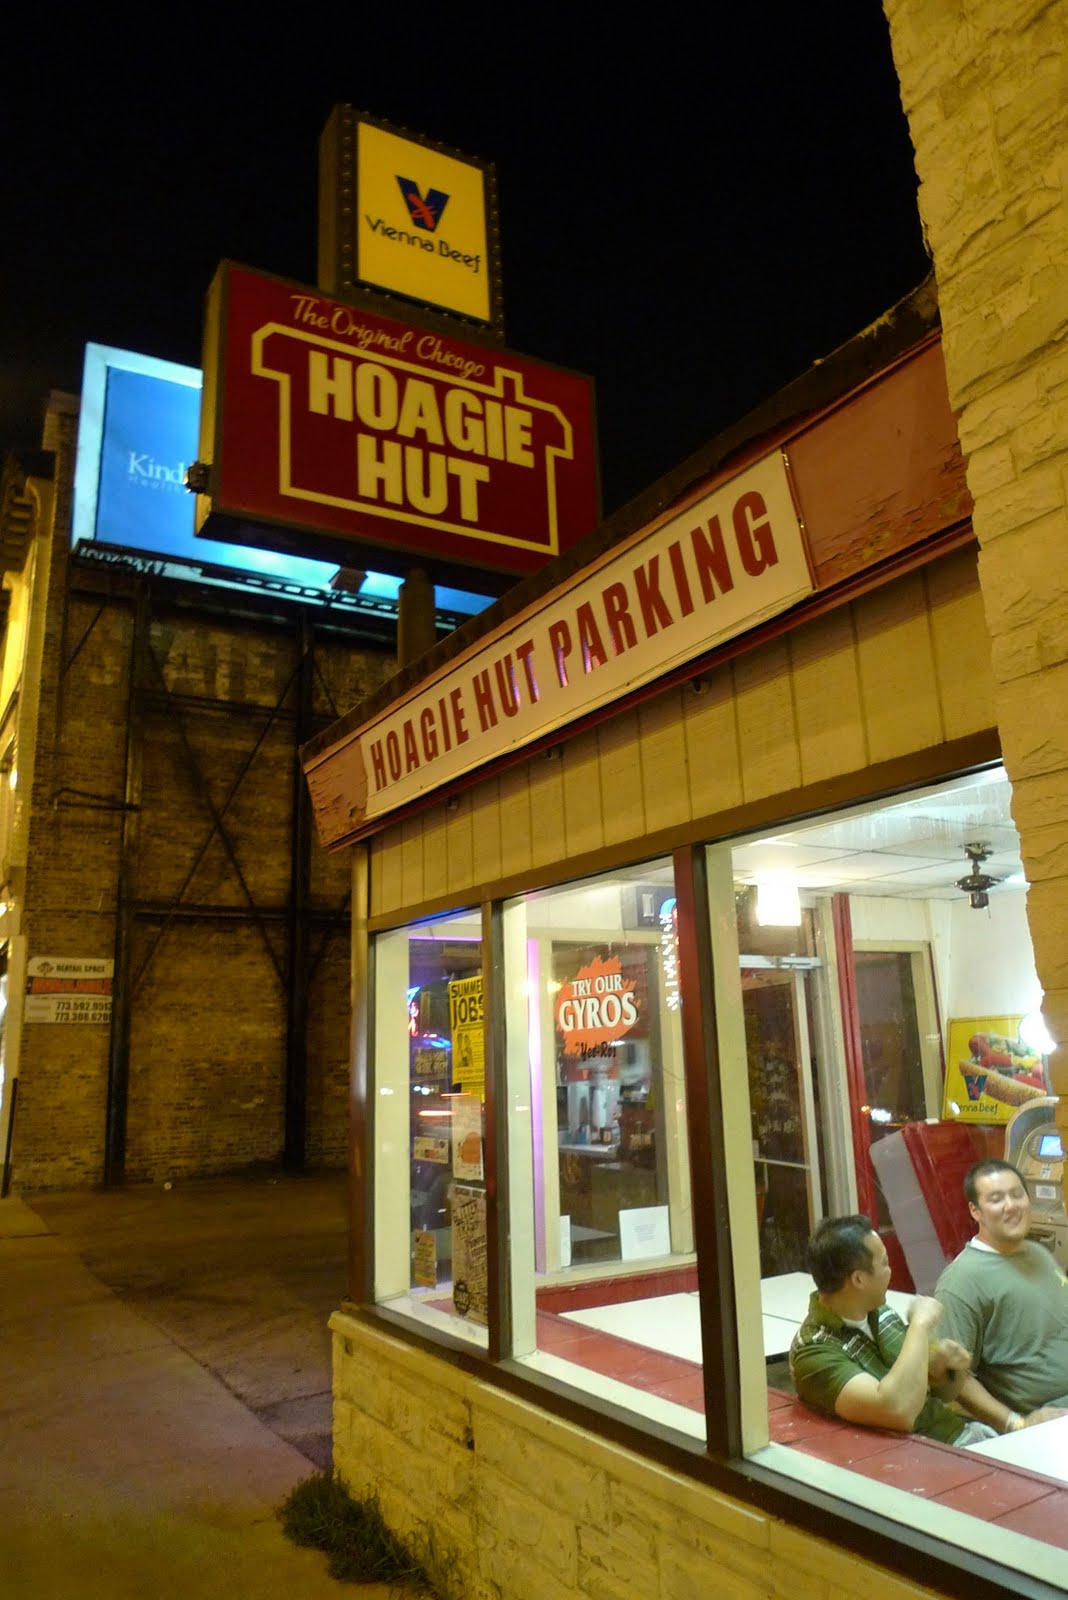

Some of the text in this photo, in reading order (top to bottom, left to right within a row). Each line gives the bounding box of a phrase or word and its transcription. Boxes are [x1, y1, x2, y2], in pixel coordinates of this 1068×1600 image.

[365, 214, 480, 273] Vienna Beef
[290, 295, 485, 378] The Original Chicago
[308, 350, 535, 468] HOAGIE
[356, 432, 490, 523] HUT
[370, 490, 780, 792] HOAGIE HUT PARKING
[559, 990, 638, 1033] GYROS
[571, 973, 624, 998] TRY OUR
[953, 1102, 998, 1115] enna Beef
